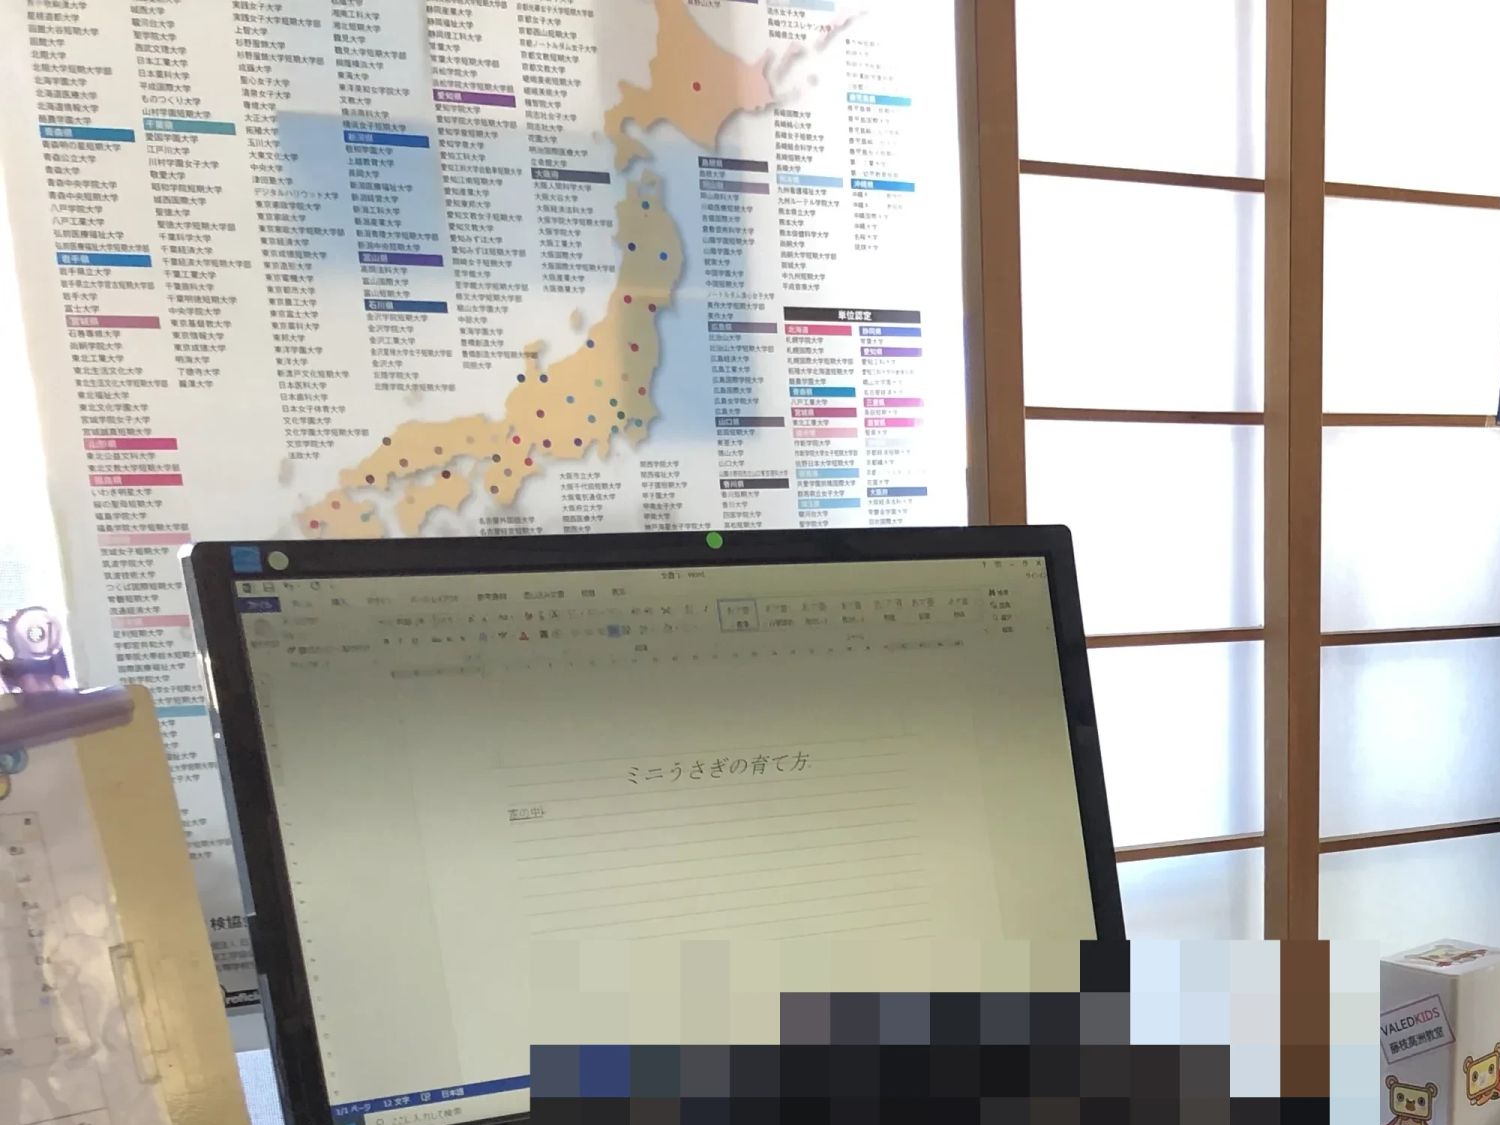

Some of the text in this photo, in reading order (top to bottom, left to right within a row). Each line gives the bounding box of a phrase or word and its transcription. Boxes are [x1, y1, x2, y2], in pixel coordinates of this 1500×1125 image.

[838, 311, 872, 321] 単位認定
[627, 751, 810, 784] ミニうさぎの育て方
[1380, 1008, 1440, 1036] VALEDKIDS
[441, 1088, 464, 1098] 日本語
[392, 1107, 462, 1125] ここに入力して検索
